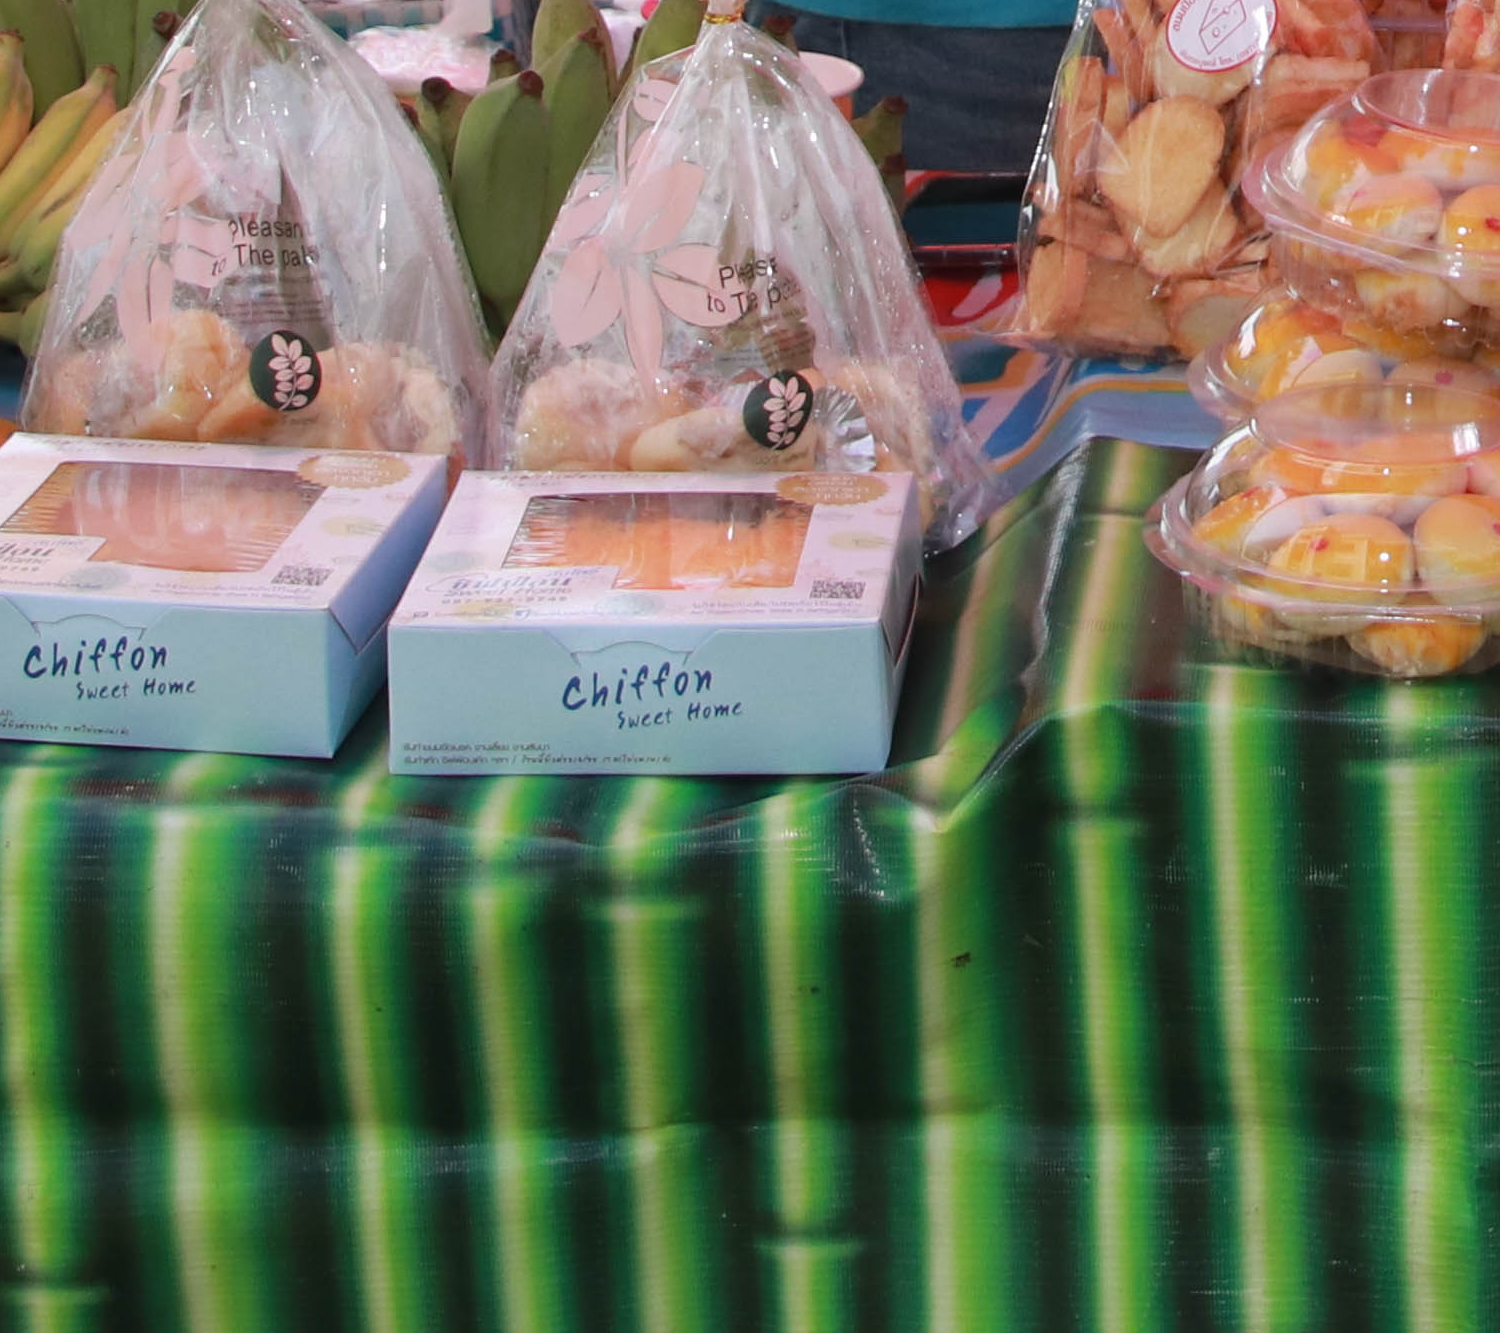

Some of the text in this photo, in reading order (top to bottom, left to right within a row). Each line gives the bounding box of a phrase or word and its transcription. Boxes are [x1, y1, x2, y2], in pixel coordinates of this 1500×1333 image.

[232, 242, 276, 269] The
[706, 292, 726, 314] to
[23, 637, 169, 679] Chiffon
[76, 678, 197, 700] Sweet Home
[561, 661, 714, 711] Chiffon
[617, 700, 744, 730] Sweet Home
